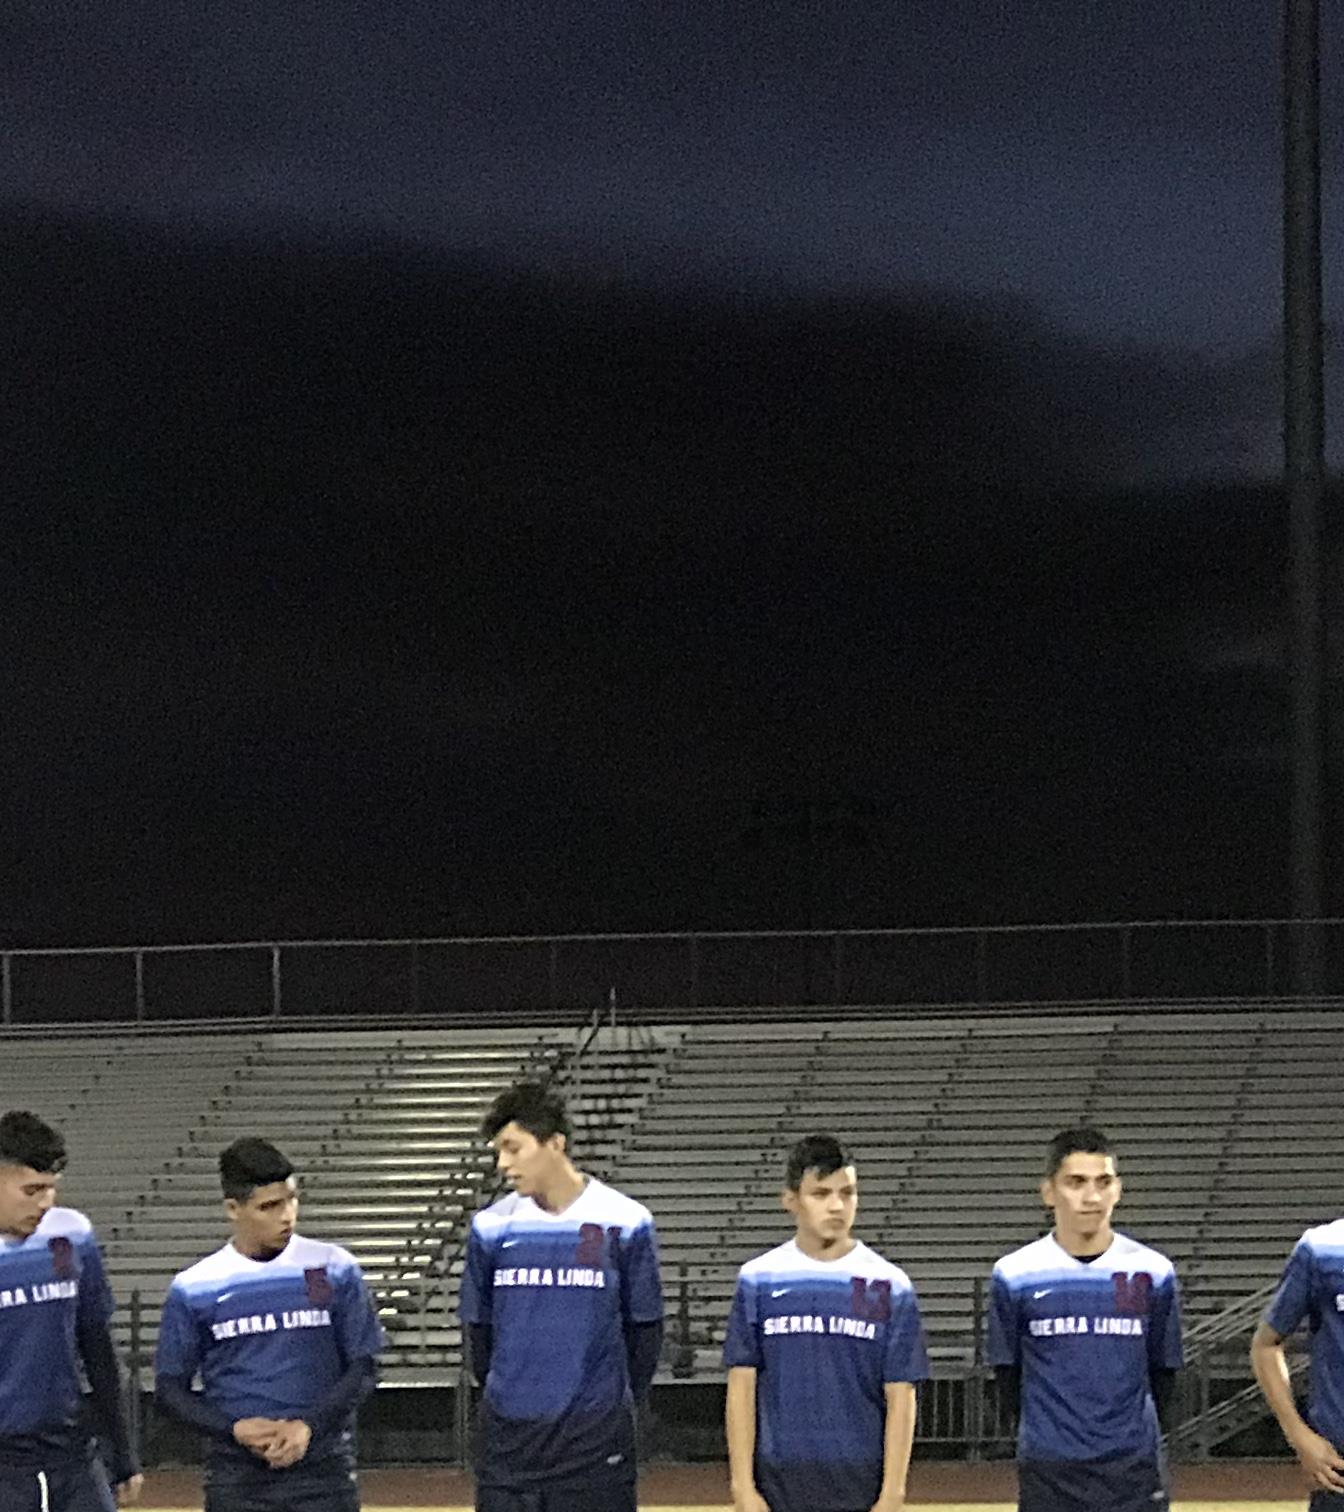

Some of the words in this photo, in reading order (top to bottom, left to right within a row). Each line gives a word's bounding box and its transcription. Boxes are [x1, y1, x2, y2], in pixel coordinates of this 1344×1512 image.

[494, 1268, 554, 1286] SIERRA
[557, 1268, 605, 1288] LINDA
[764, 1315, 824, 1335] SIERRA
[829, 1316, 875, 1340] LINDA
[1094, 1318, 1143, 1335] LINDA
